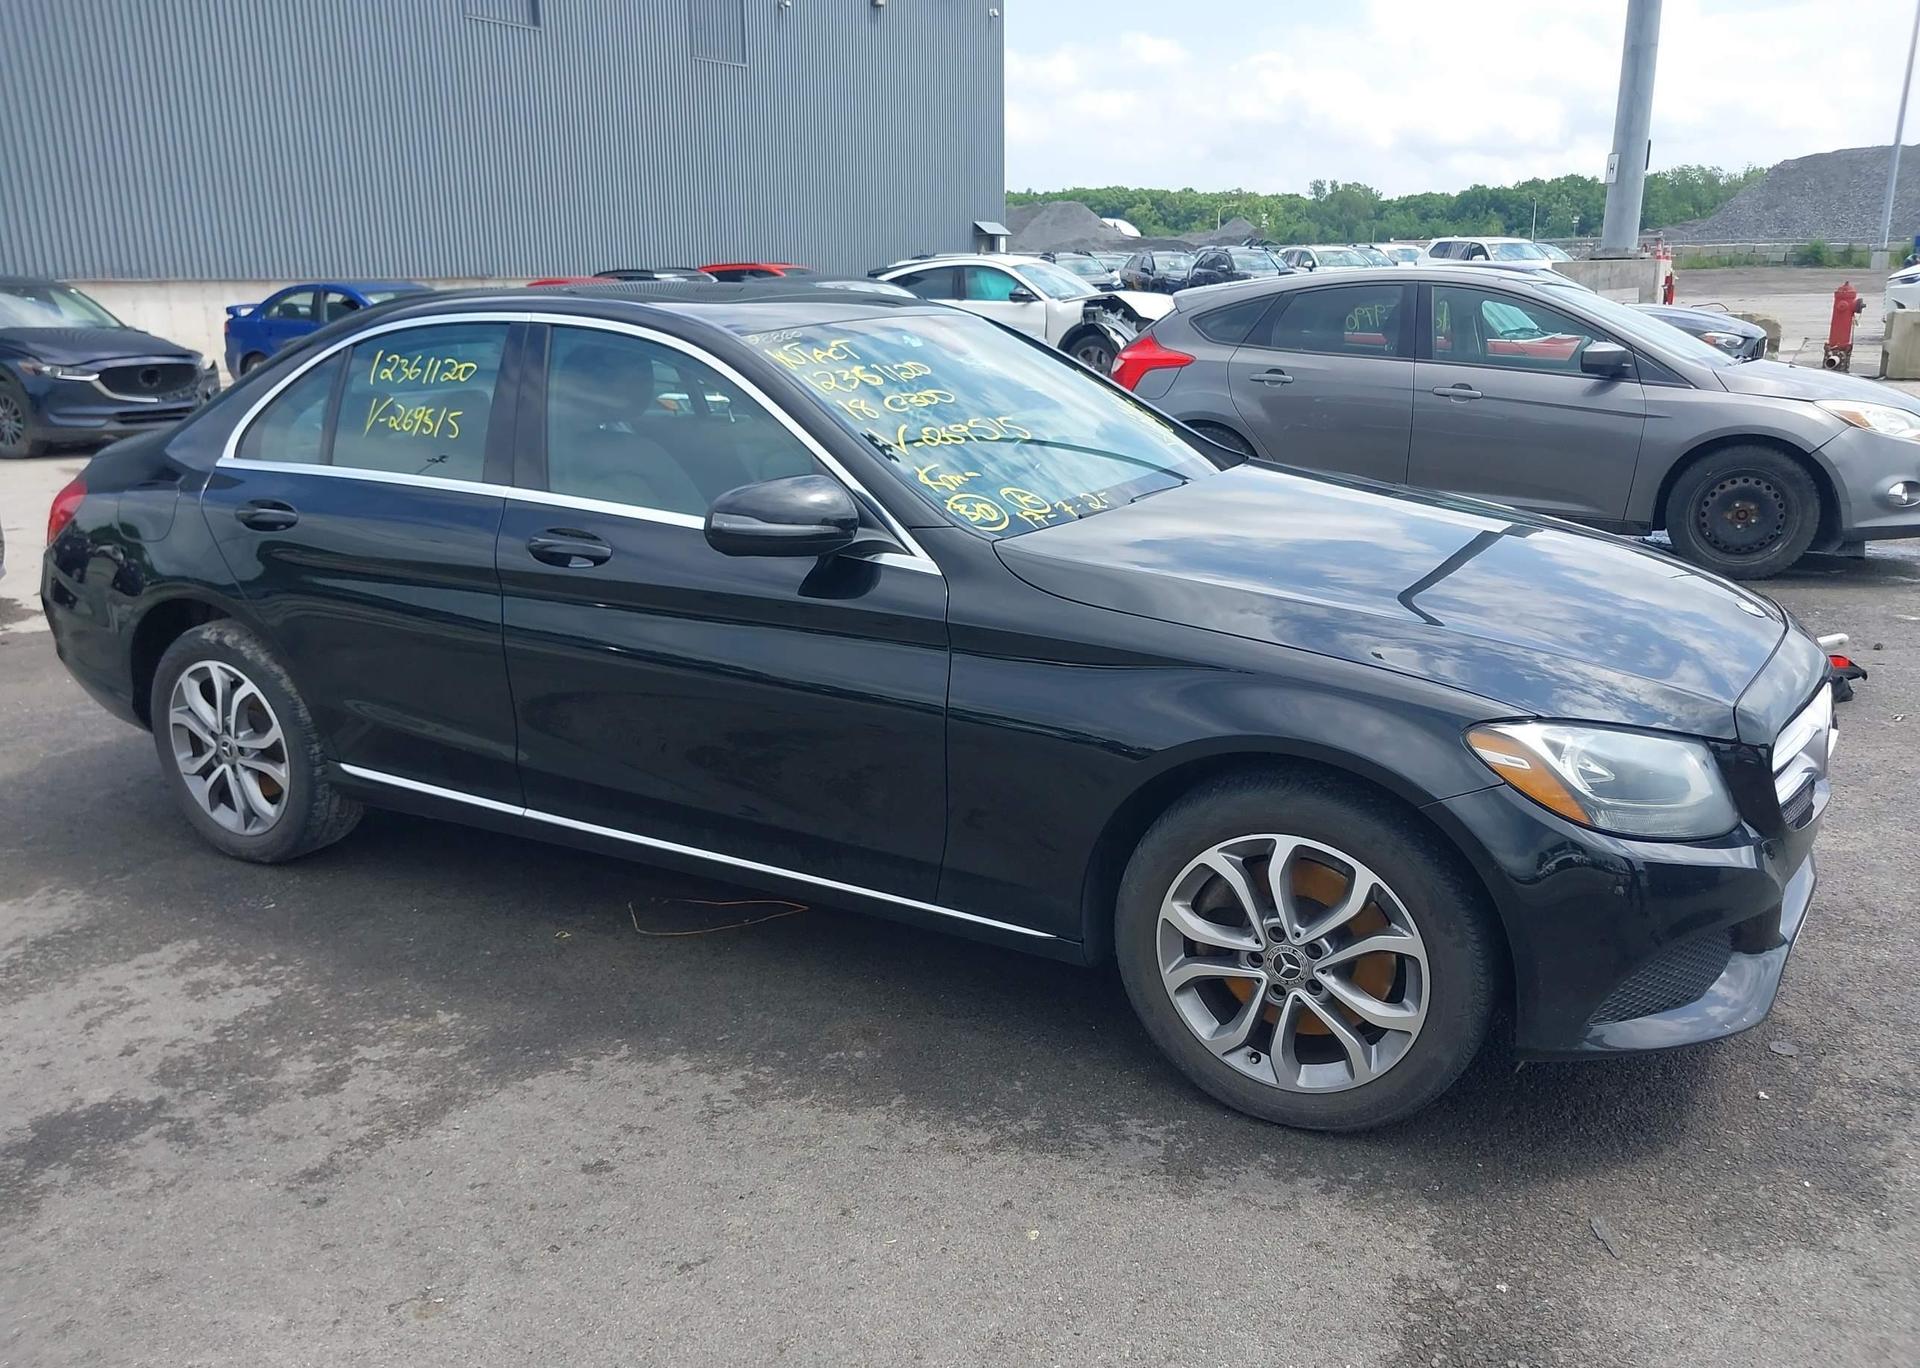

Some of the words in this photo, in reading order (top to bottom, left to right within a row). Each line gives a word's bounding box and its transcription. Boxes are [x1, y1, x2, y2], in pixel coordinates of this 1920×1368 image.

[1609, 162, 1616, 175] H
[370, 350, 478, 385] 12361120
[363, 397, 464, 440] V-269515
[836, 398, 880, 421] 18
[868, 416, 1032, 456] V-269515
